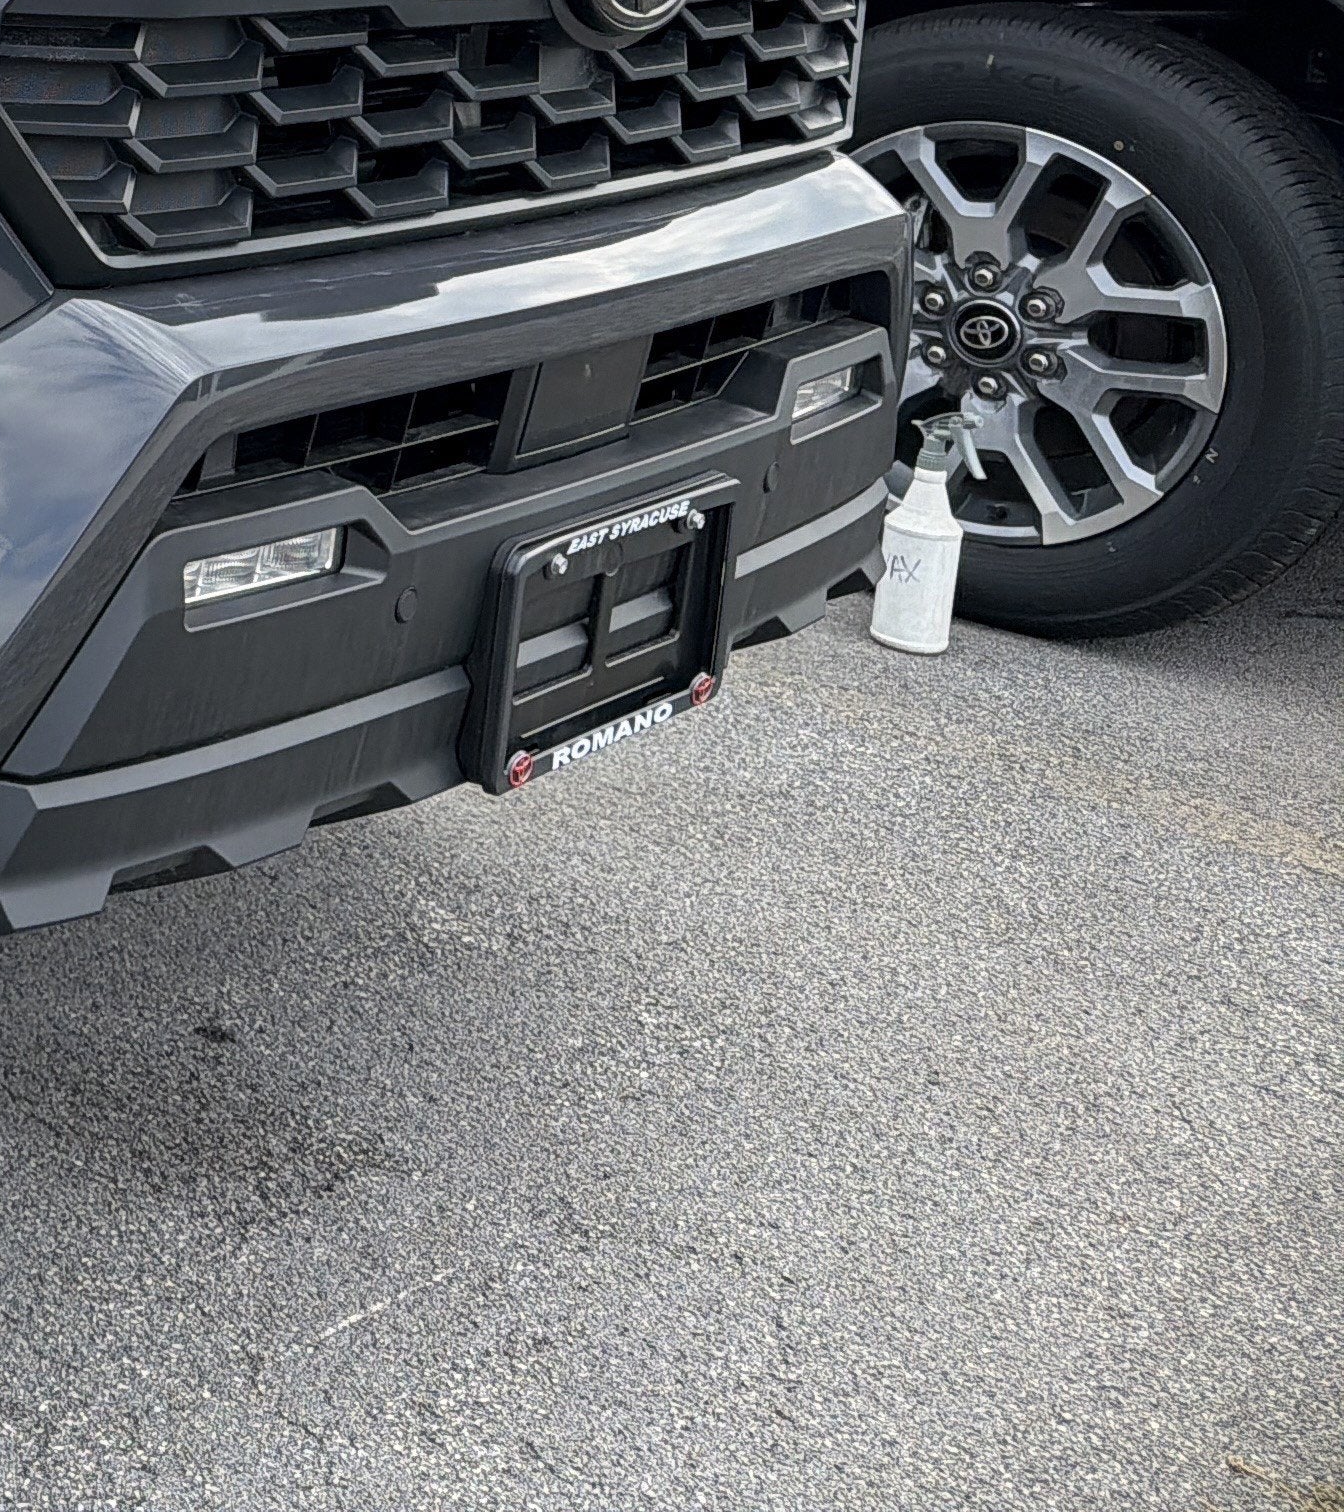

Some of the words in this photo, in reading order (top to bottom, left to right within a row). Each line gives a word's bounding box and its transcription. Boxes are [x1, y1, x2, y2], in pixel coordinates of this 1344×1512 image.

[566, 527, 609, 555] EAST
[608, 499, 691, 540] SYRACUSE
[886, 553, 923, 585] AX
[551, 701, 674, 771] ROMANO
